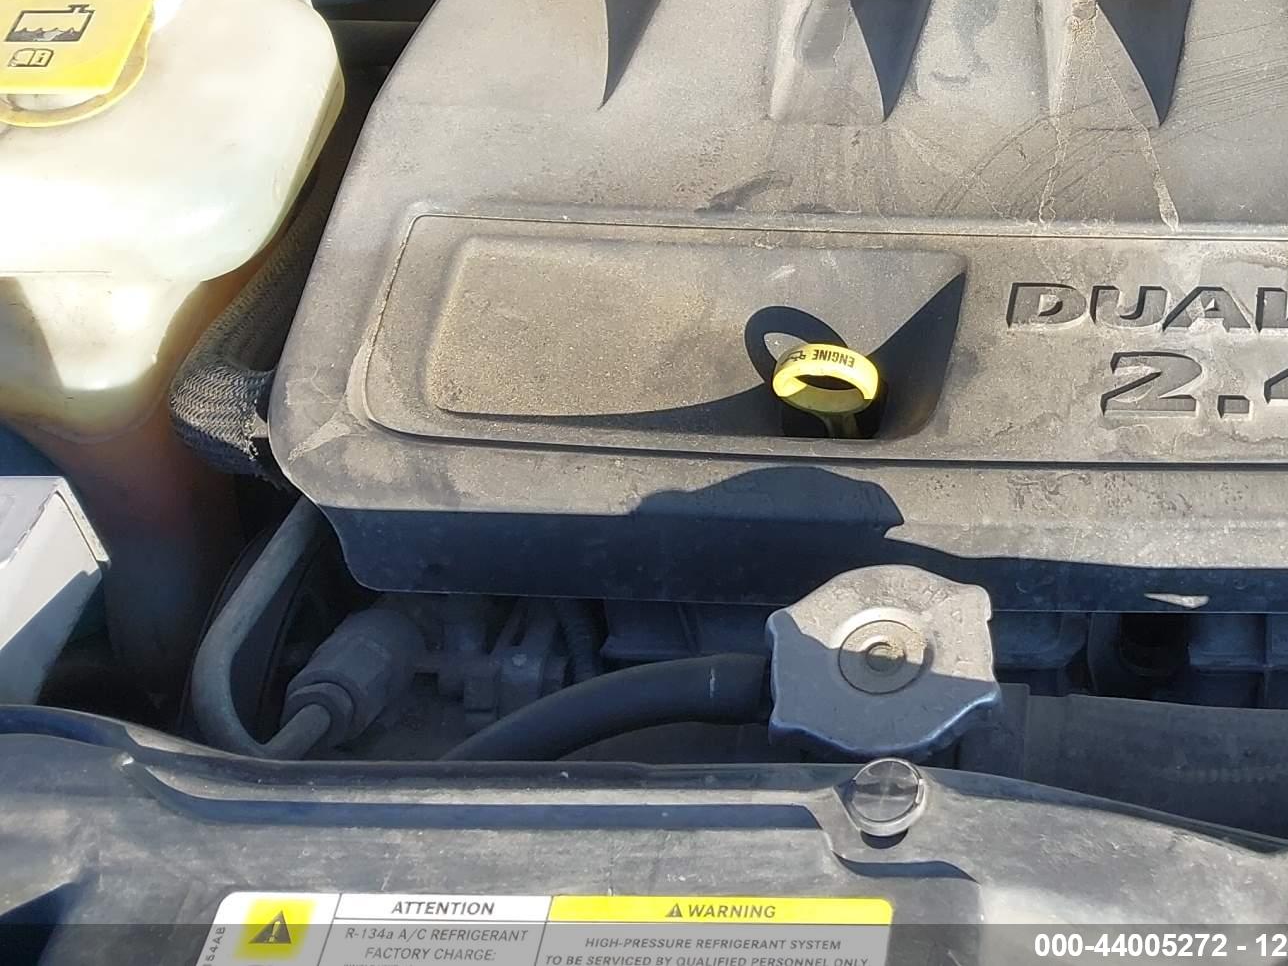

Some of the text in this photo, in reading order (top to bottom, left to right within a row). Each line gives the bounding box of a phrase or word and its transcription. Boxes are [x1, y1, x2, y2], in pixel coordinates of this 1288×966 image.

[811, 349, 855, 368] ENGINE
[391, 901, 495, 915] ATTENTION
[688, 904, 776, 918] WARNING
[345, 927, 528, 942] R-134a A/C REFRIGERANT
[585, 937, 842, 950] HIGH-PRESSURE REFRIGERANT SYSTEM
[365, 947, 496, 961] FACTORY CHARGE:
[546, 955, 562, 965] TO
[566, 955, 582, 965] BE
[586, 956, 651, 966] SERVICED
[655, 956, 672, 966] BY
[676, 956, 747, 966] QUALIFIED
[751, 957, 828, 966] PERSONNEL
